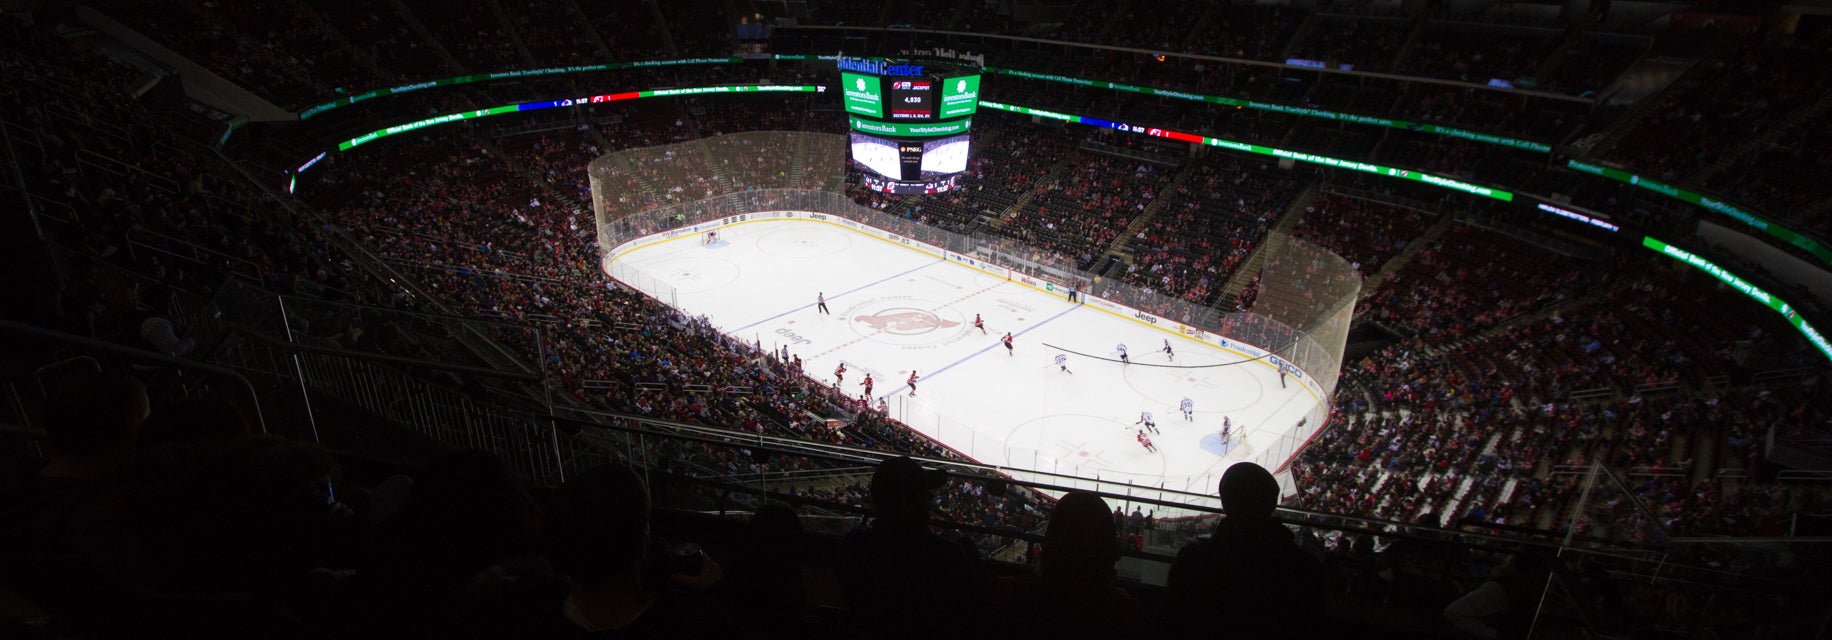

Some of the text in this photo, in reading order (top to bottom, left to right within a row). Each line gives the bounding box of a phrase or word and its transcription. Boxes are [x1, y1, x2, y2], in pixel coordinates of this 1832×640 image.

[880, 61, 924, 77] Center
[861, 123, 897, 133] investorsBank
[909, 124, 960, 134] YourStyleChecking.com
[1273, 149, 1292, 157] Official
[1293, 151, 1308, 160] Bank
[1325, 157, 1339, 165] New
[1338, 159, 1359, 169] Jersey
[809, 212, 827, 221] Jeep
[1134, 310, 1157, 325] Jeep
[774, 328, 812, 345] Jeep
[1229, 342, 1261, 357] Prudential
[1269, 355, 1303, 378] GEICO
